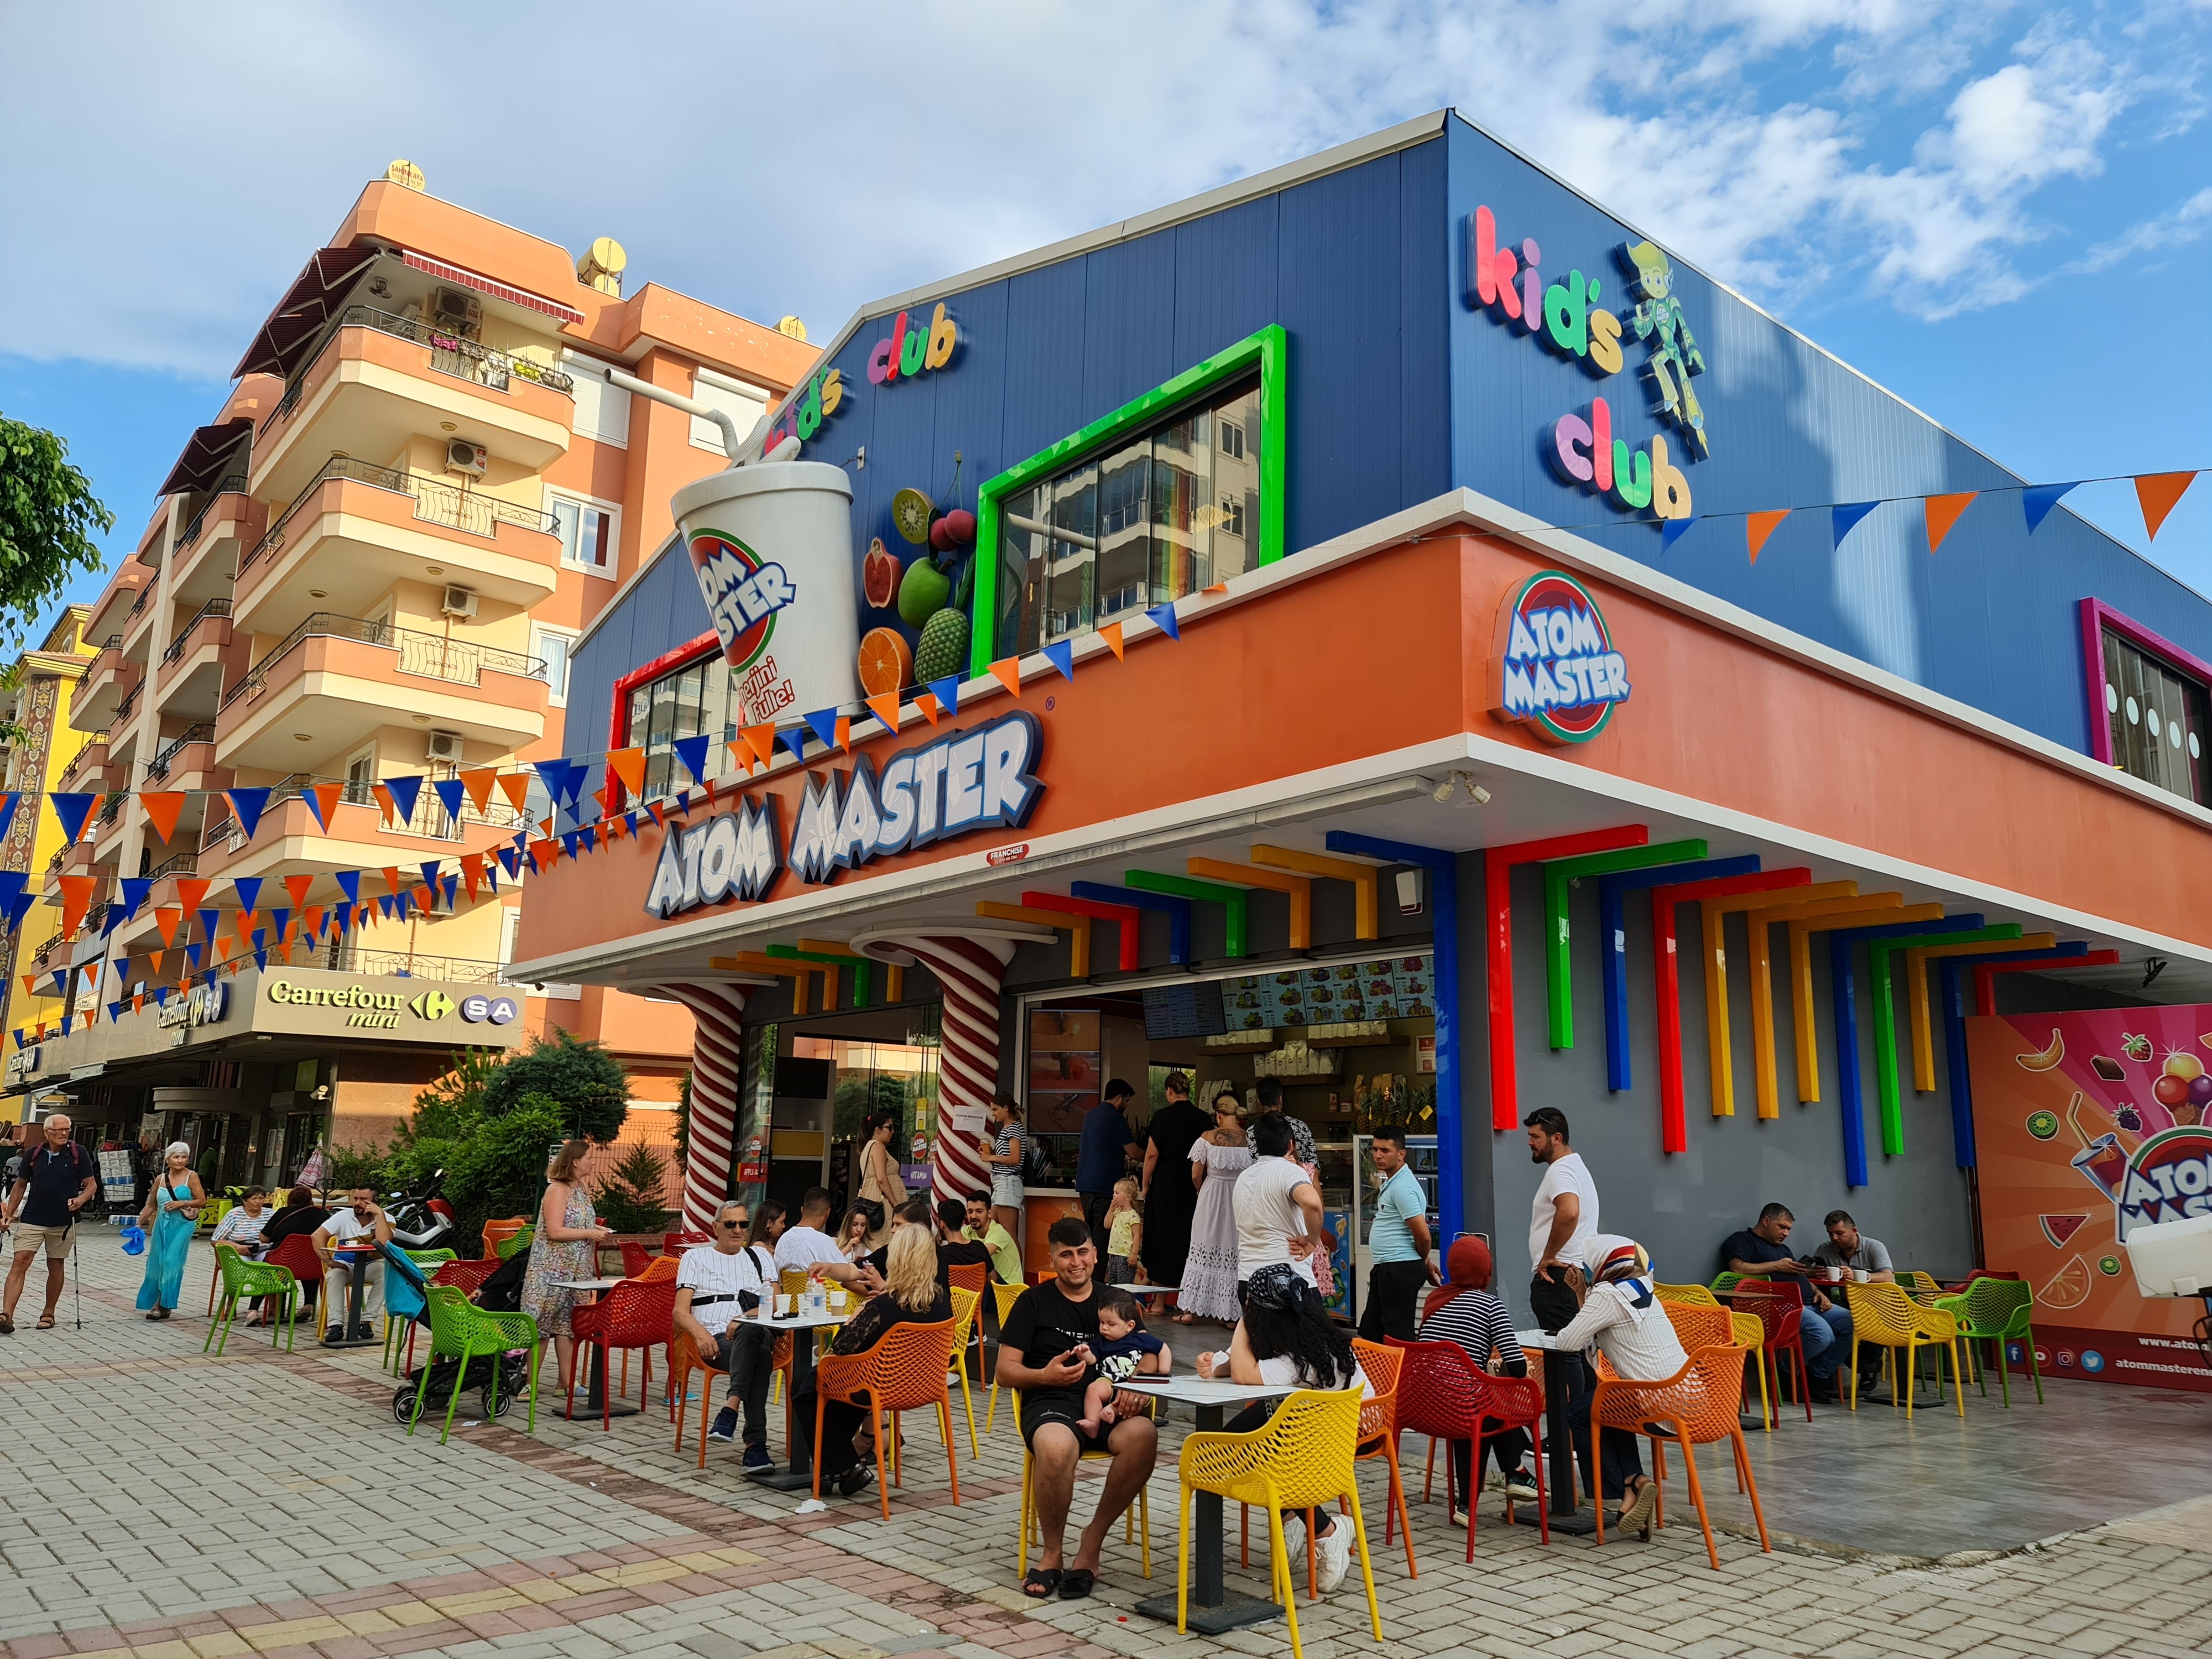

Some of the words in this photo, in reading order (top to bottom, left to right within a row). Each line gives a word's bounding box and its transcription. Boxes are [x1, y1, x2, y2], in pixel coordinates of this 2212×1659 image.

[1477, 205, 1623, 373] kid's
[867, 302, 957, 385] club
[1556, 397, 1692, 519] club
[1508, 602, 1603, 661] ATOM
[738, 655, 778, 707] nerjini
[1504, 653, 1630, 715] MASTER
[646, 799, 775, 915] ATOM
[790, 715, 1036, 877] MASTER
[990, 846, 1024, 860] FRANCHISE
[270, 980, 404, 1010] Carrefour
[468, 1000, 514, 1019] SA
[348, 1011, 403, 1029] mini
[910, 1171, 927, 1180] VITAMIN
[2124, 1153, 2212, 1206] ATO
[2121, 1196, 2212, 1240] MAS
